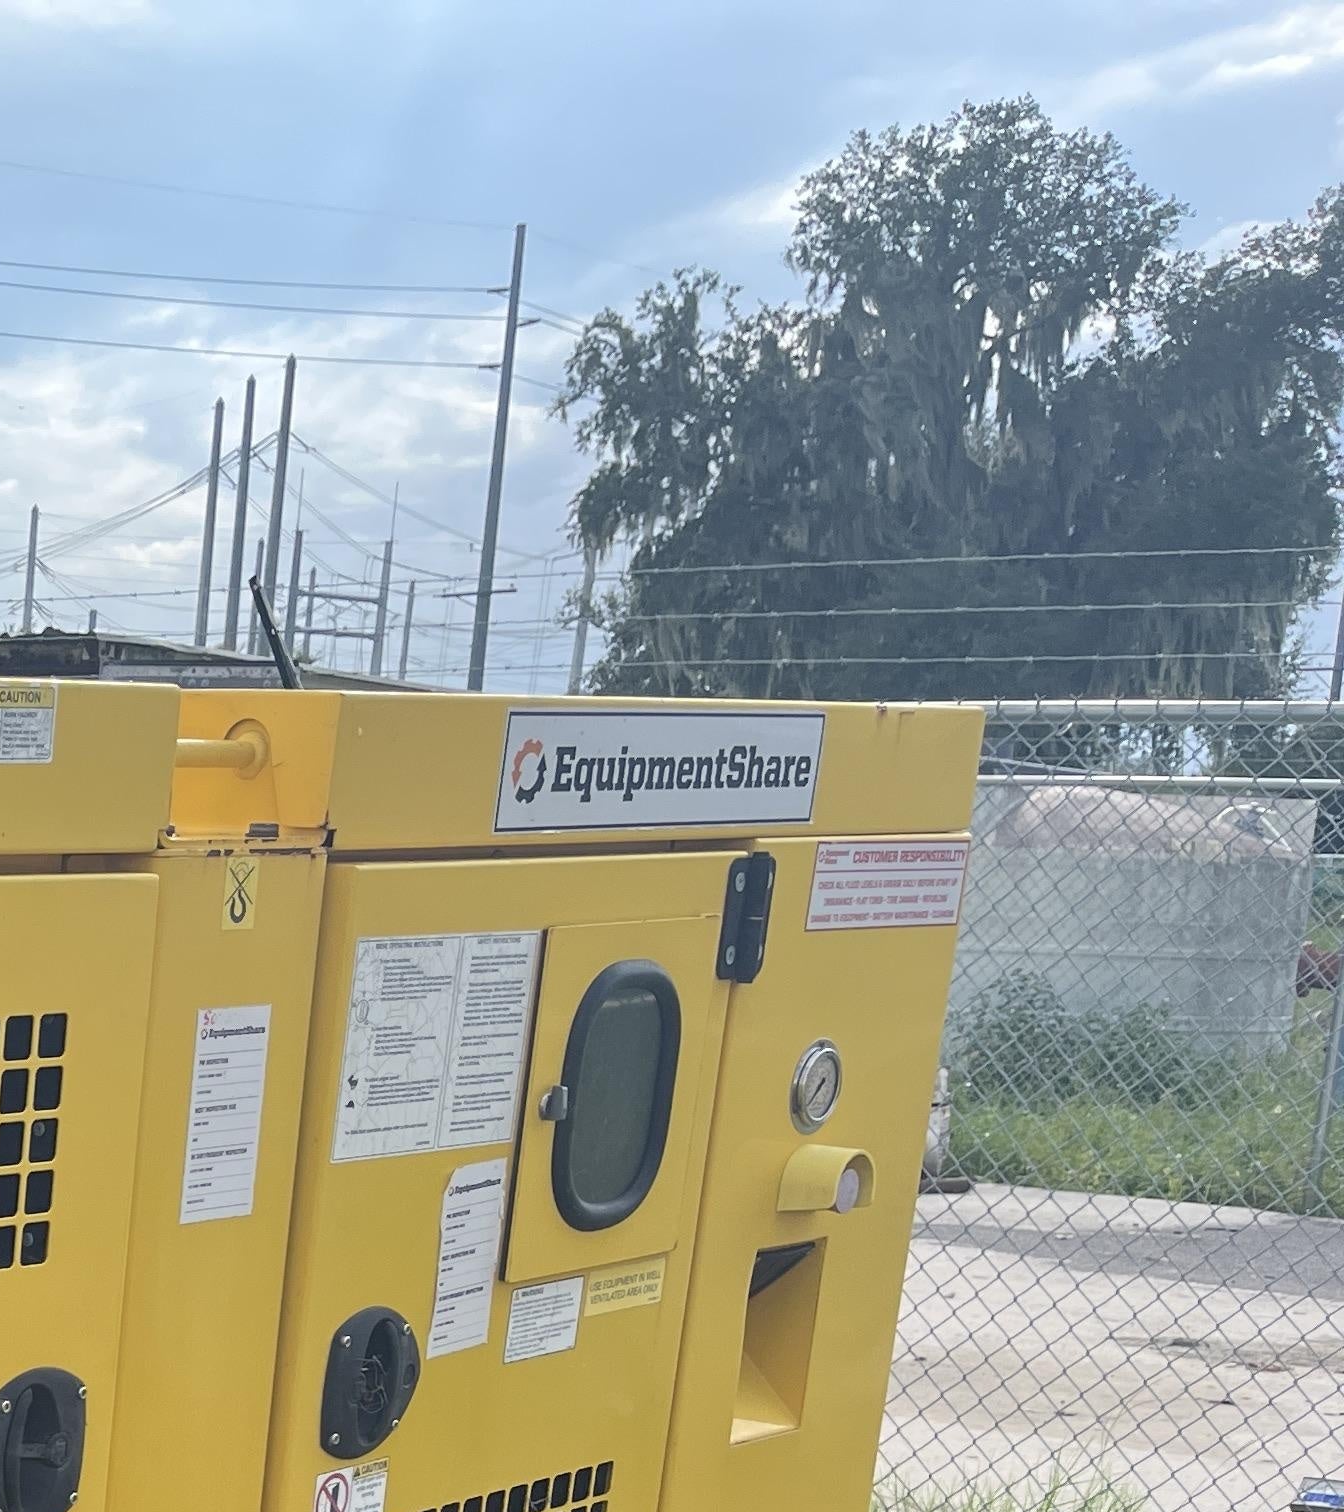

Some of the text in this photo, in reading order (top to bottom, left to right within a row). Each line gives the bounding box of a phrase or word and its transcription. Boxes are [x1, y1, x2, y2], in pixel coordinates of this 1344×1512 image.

[0, 691, 41, 703] CAUTION
[551, 745, 810, 803] EquipmentShare
[853, 851, 899, 863] CUSTOMER
[900, 850, 965, 863] RESPONSIBILITY
[590, 1270, 662, 1292] USE EQUIPMENT IN WELL
[590, 1282, 659, 1304] VENTILATED AREA ONLY
